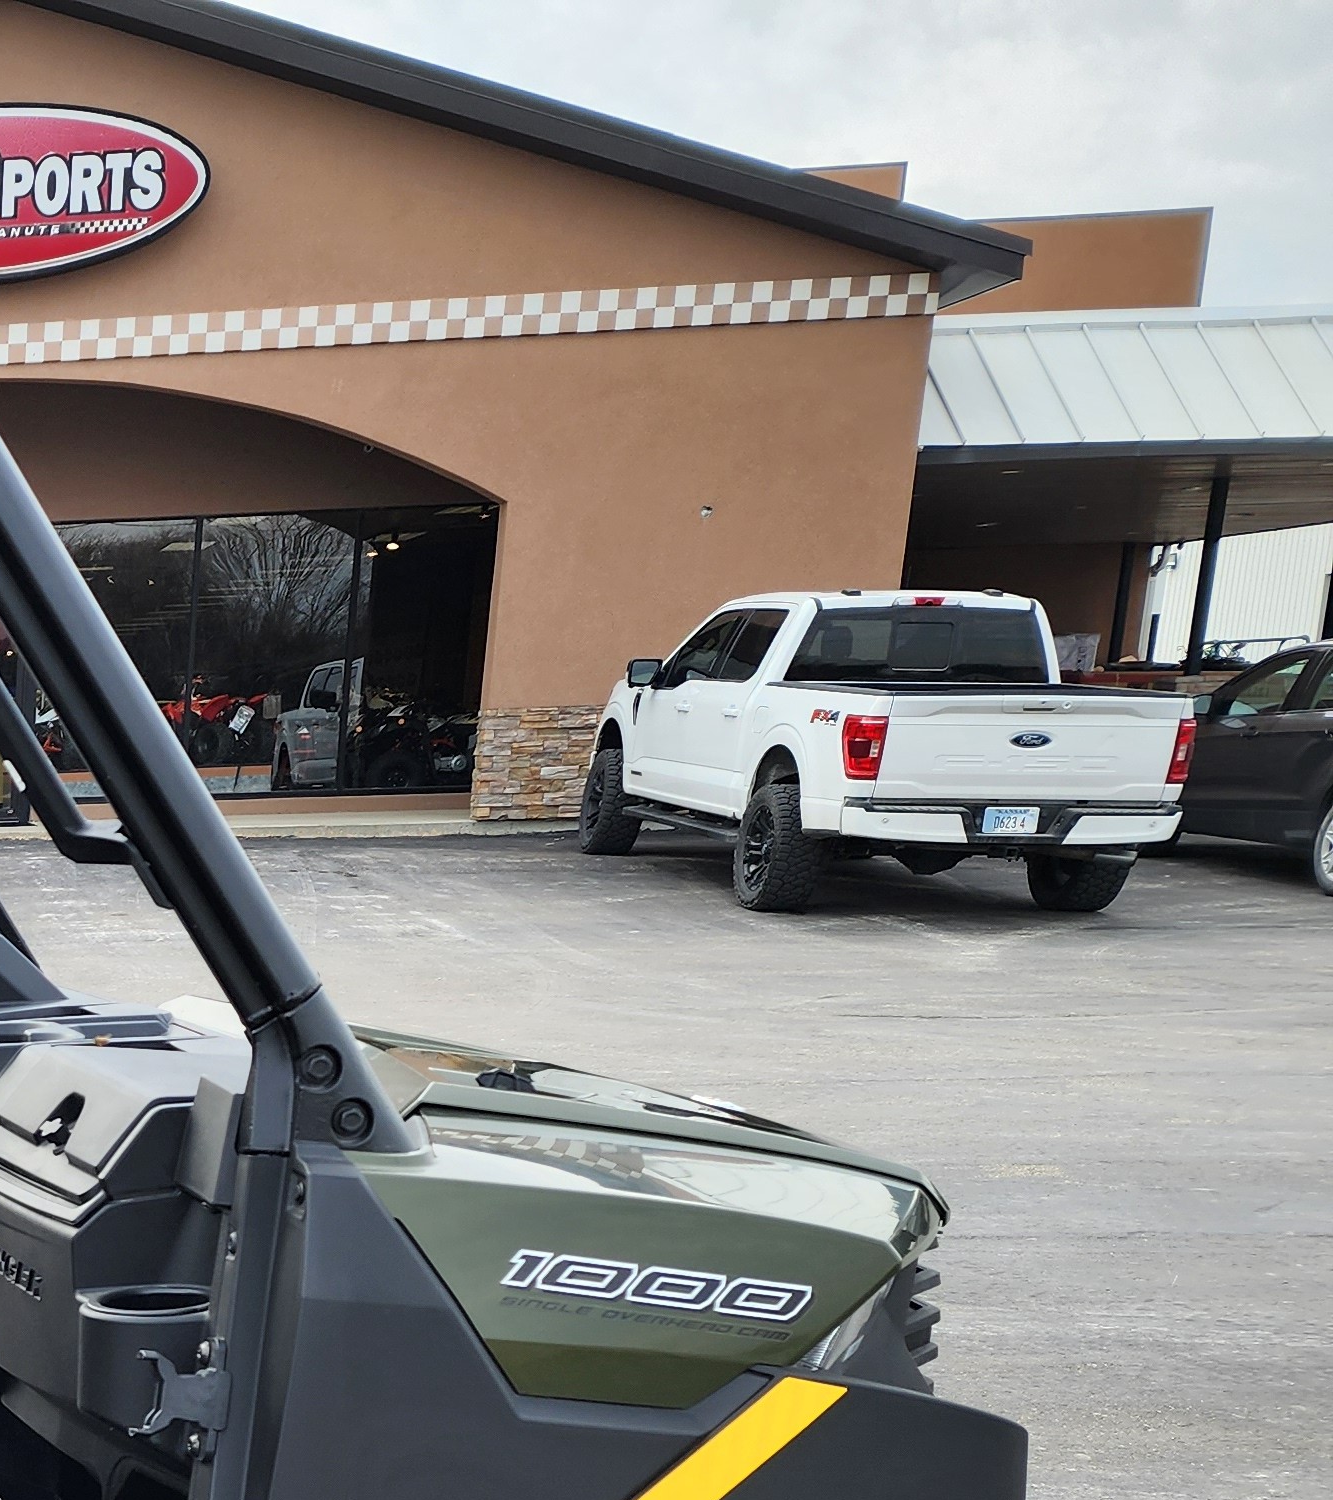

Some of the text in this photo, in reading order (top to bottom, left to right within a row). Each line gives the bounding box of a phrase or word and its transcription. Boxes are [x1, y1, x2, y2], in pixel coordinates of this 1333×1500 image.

[810, 708, 841, 724] FX4
[1018, 734, 1046, 747] Ford
[499, 1247, 815, 1324] 1000
[498, 1295, 792, 1342] SINGLE OVERHEAD CAM
